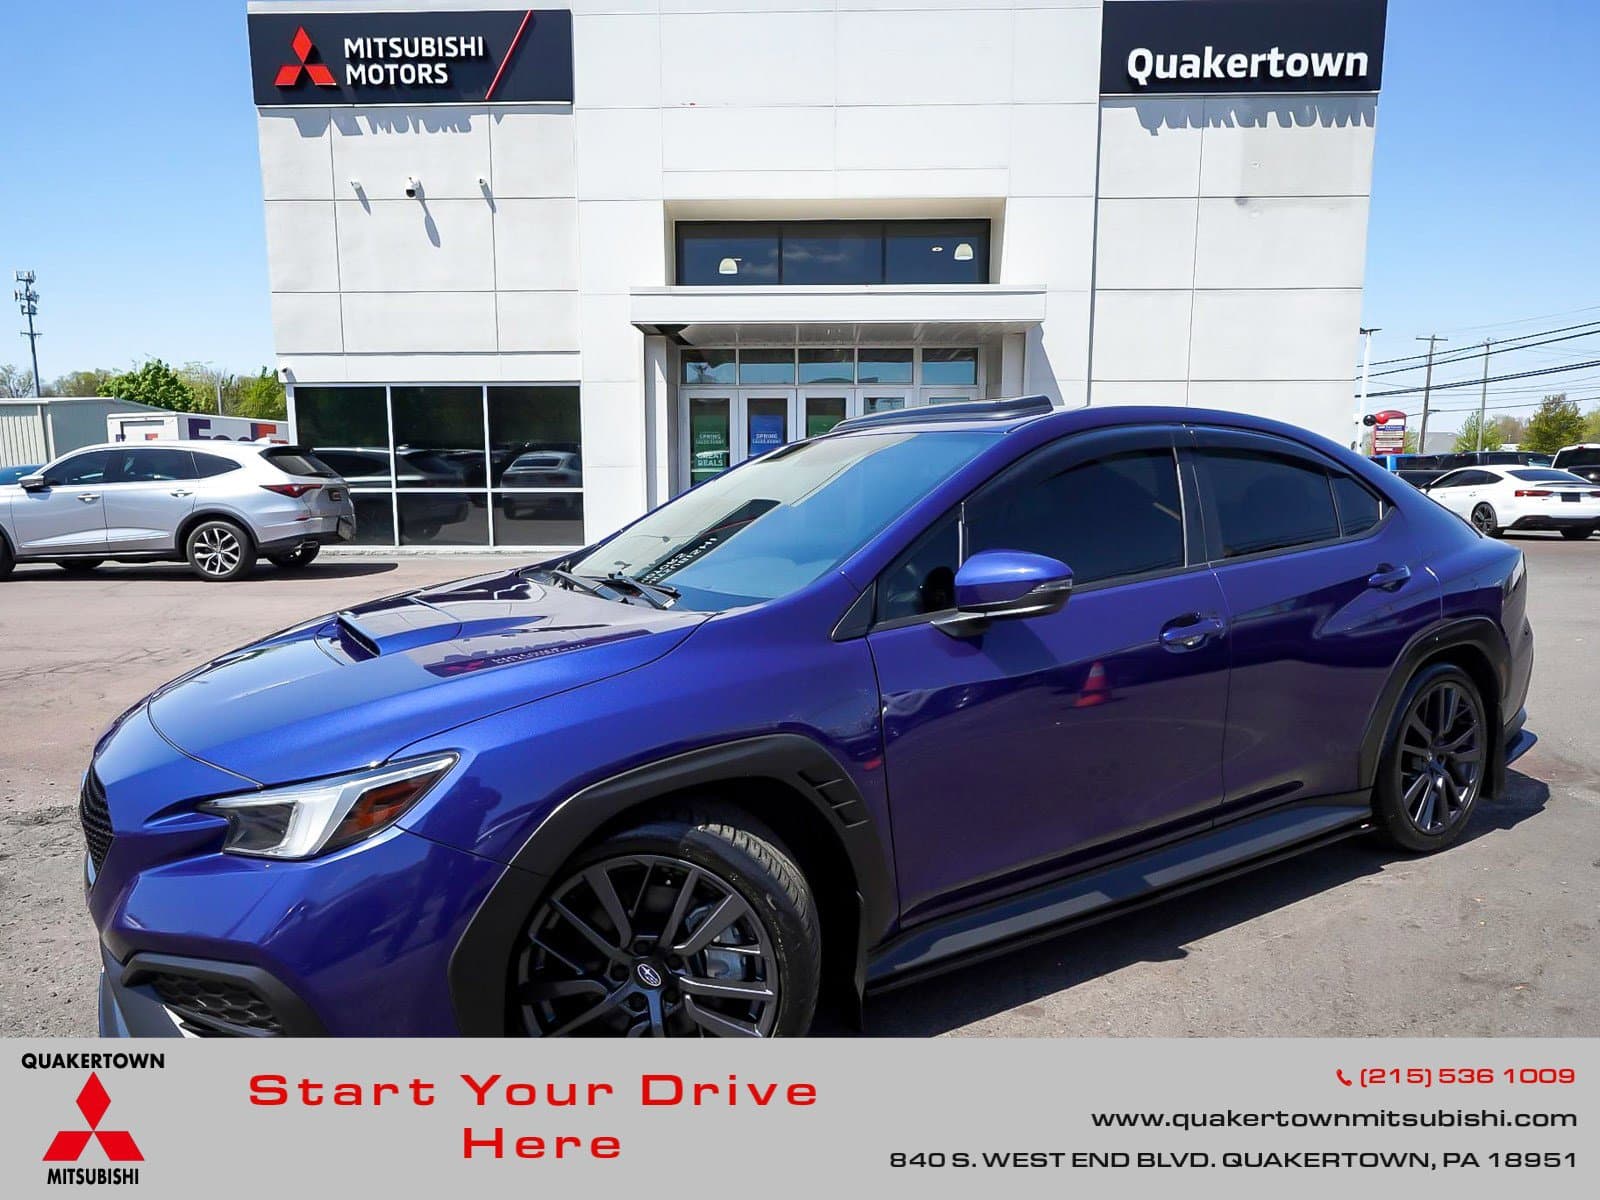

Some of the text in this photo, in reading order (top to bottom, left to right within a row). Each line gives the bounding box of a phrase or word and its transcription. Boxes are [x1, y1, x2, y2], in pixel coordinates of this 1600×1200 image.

[344, 36, 484, 59] MITSUBISHI
[346, 63, 448, 86] MOTORS
[1127, 46, 1369, 87] Quakertown
